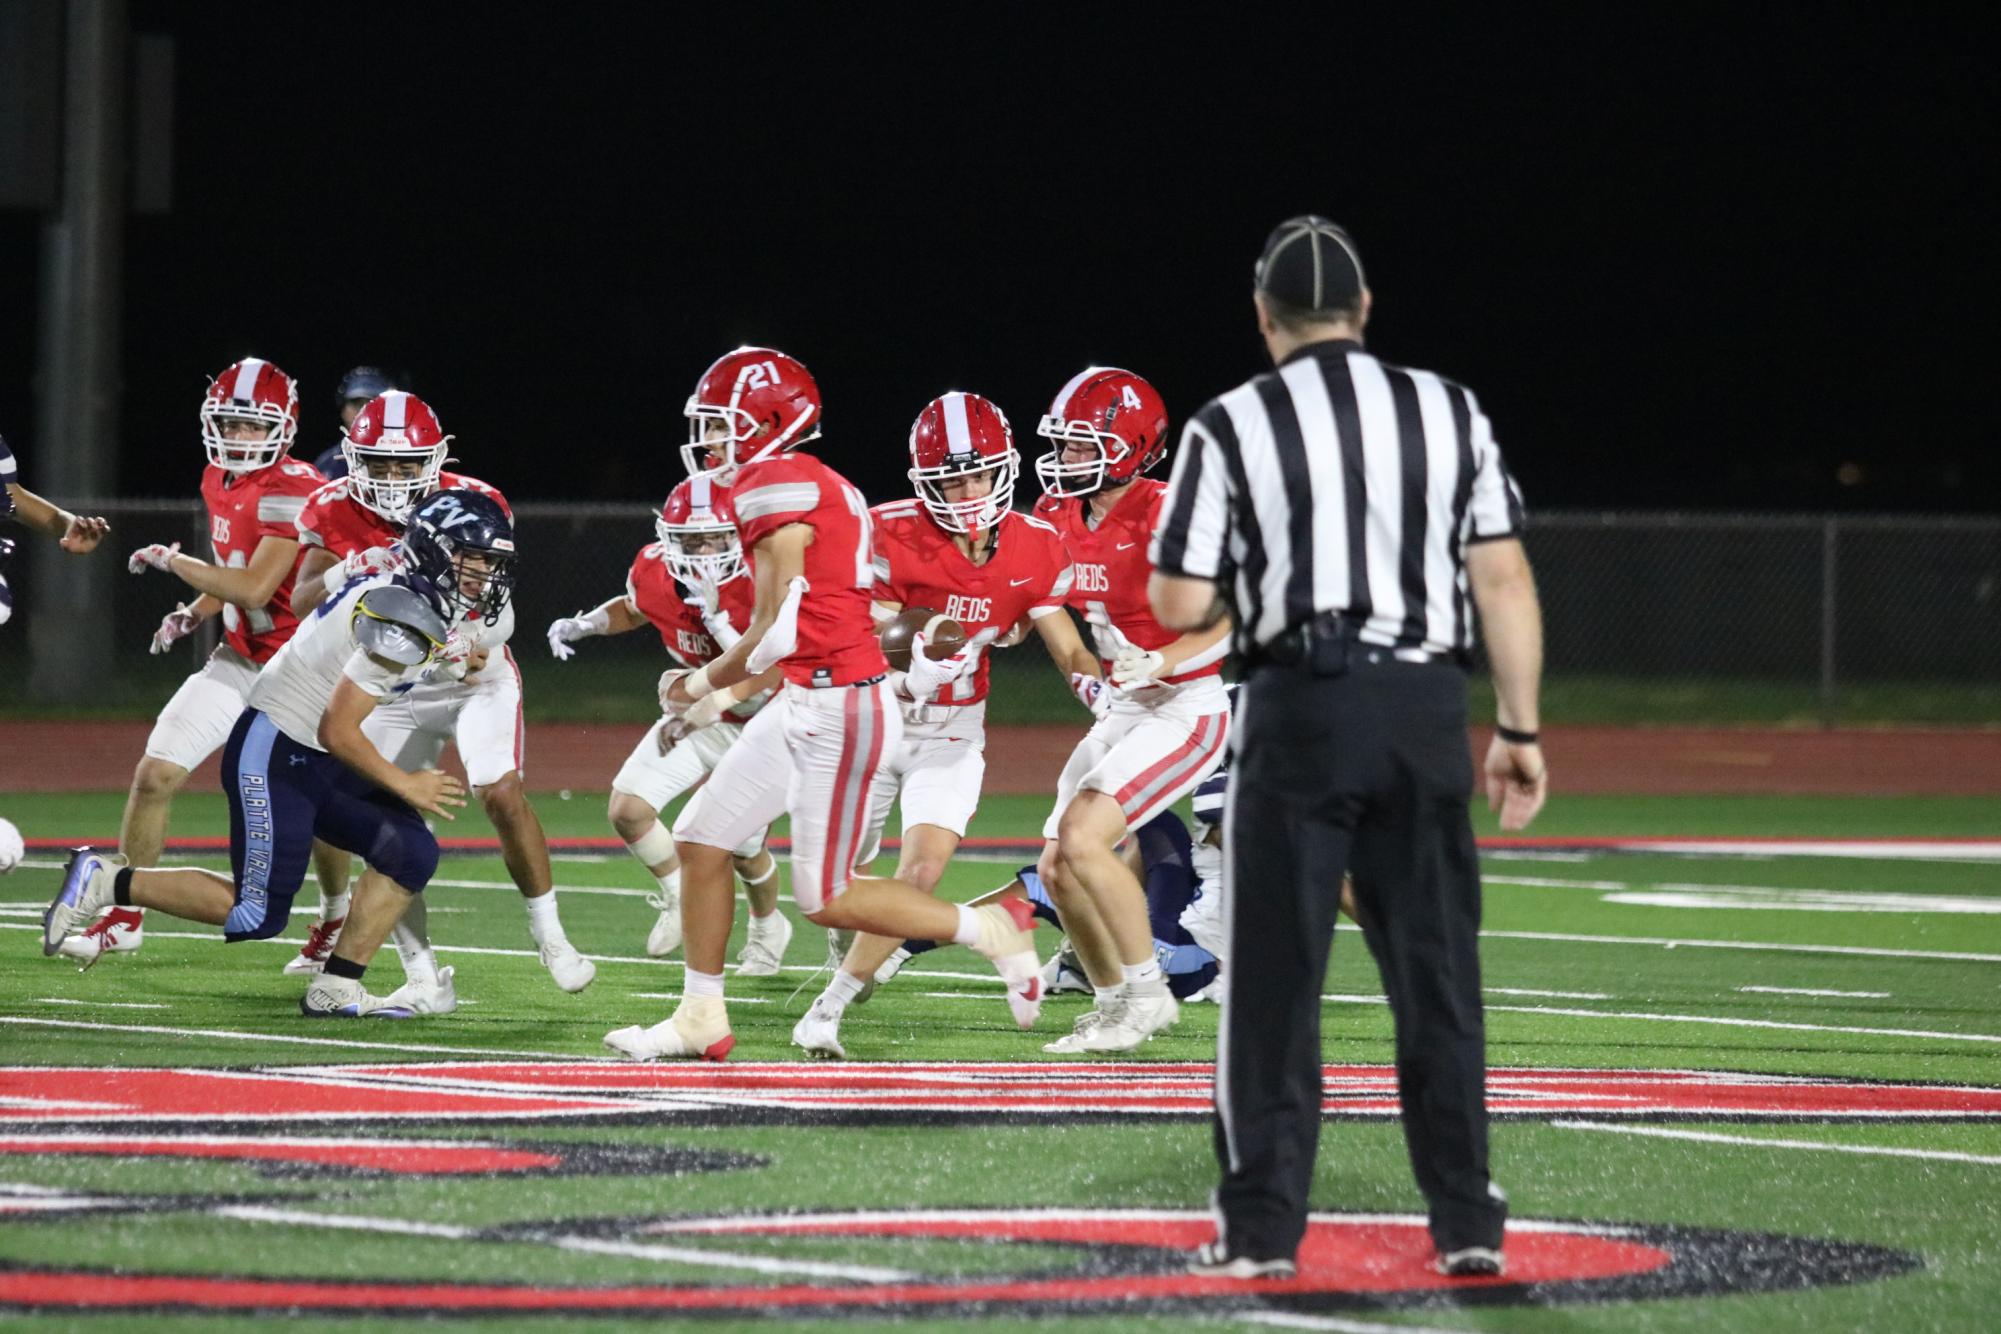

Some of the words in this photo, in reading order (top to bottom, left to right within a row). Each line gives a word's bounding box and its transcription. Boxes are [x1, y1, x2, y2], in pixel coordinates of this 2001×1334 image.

[748, 360, 781, 390] 21
[1122, 385, 1141, 410] 4
[419, 496, 480, 529] PV
[1074, 563, 1109, 592] REDS
[945, 594, 992, 622] REDS
[676, 628, 711, 656] REDS
[242, 774, 270, 842] PLATTE
[241, 848, 269, 907] VALLEY
[311, 988, 340, 1013] NIKE
